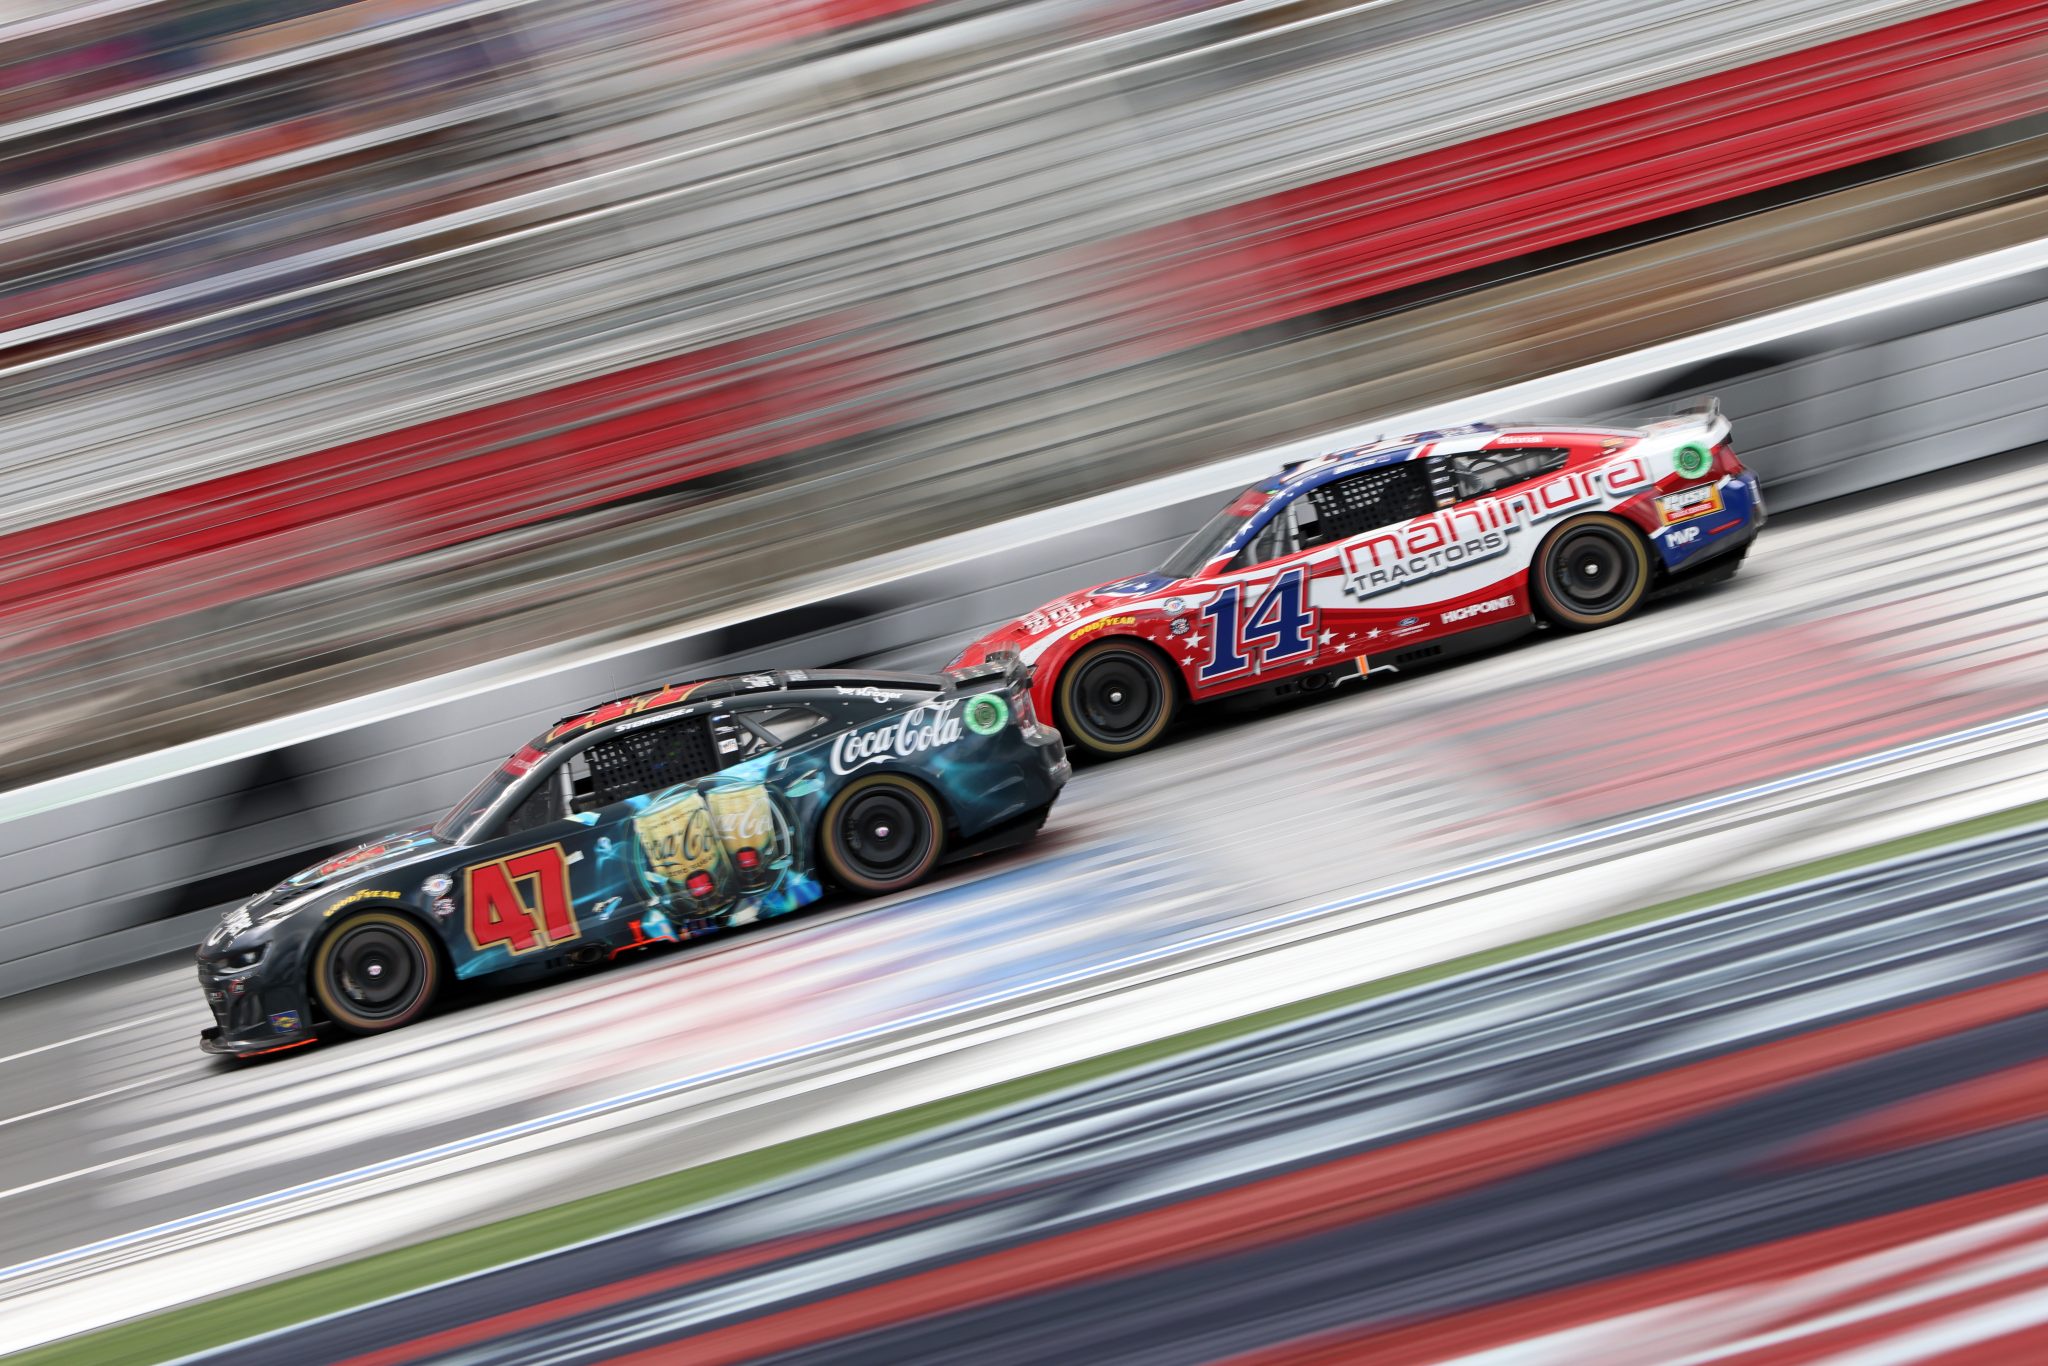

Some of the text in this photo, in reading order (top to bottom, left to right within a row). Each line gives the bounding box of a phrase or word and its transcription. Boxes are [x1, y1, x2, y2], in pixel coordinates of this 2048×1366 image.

[1344, 457, 1647, 573] mahindra
[1665, 526, 1700, 547] MVP
[1353, 532, 1502, 591] TRACTORS
[1069, 616, 1136, 641] GOODYEAR
[1199, 565, 1316, 682] 14
[830, 699, 962, 775] Coca-Cola
[464, 842, 582, 956] 47
